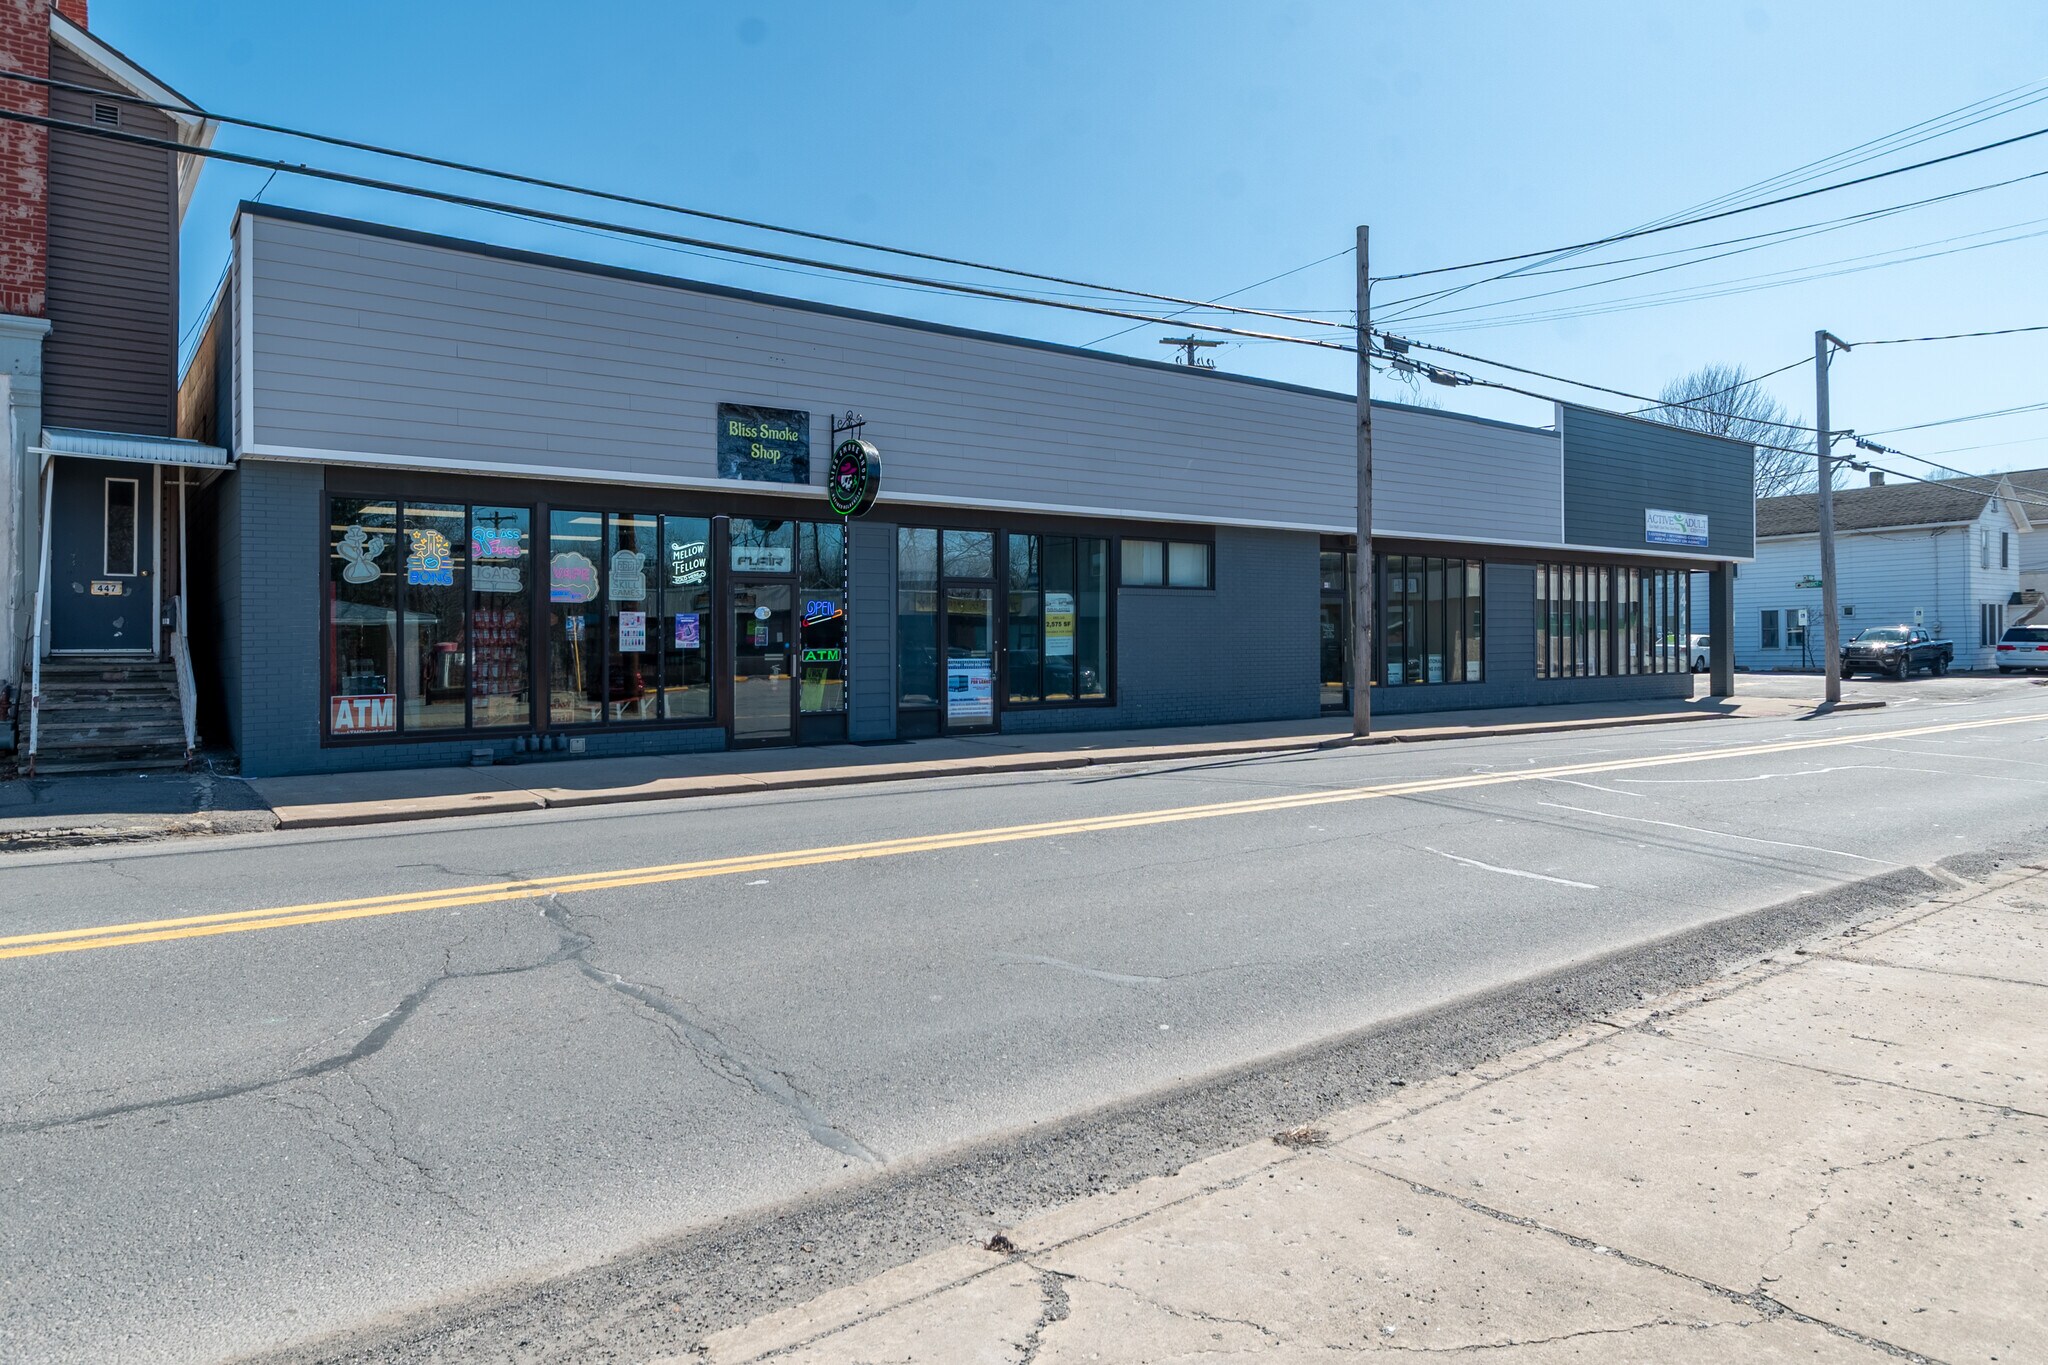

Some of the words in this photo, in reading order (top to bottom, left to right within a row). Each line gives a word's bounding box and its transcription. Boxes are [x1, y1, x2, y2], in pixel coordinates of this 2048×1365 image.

[729, 420, 758, 438] Bliss
[759, 423, 799, 441] Smoke
[750, 443, 781, 465] Shop
[839, 444, 861, 457] SMOKE
[859, 453, 867, 482] SHOP
[1647, 514, 1675, 526] ACTIVE
[1684, 518, 1708, 529] ADULT
[486, 530, 520, 539] GLASS
[491, 546, 520, 556] PIPES
[673, 545, 705, 560] MELLOW
[552, 567, 590, 581] VAPE
[672, 558, 706, 575] FELLOW
[410, 569, 452, 584] BONG
[97, 584, 117, 592] 447
[613, 581, 639, 589] SKILL
[806, 600, 835, 616] OPEN
[805, 649, 839, 661] ATM
[335, 698, 393, 729] ATM
